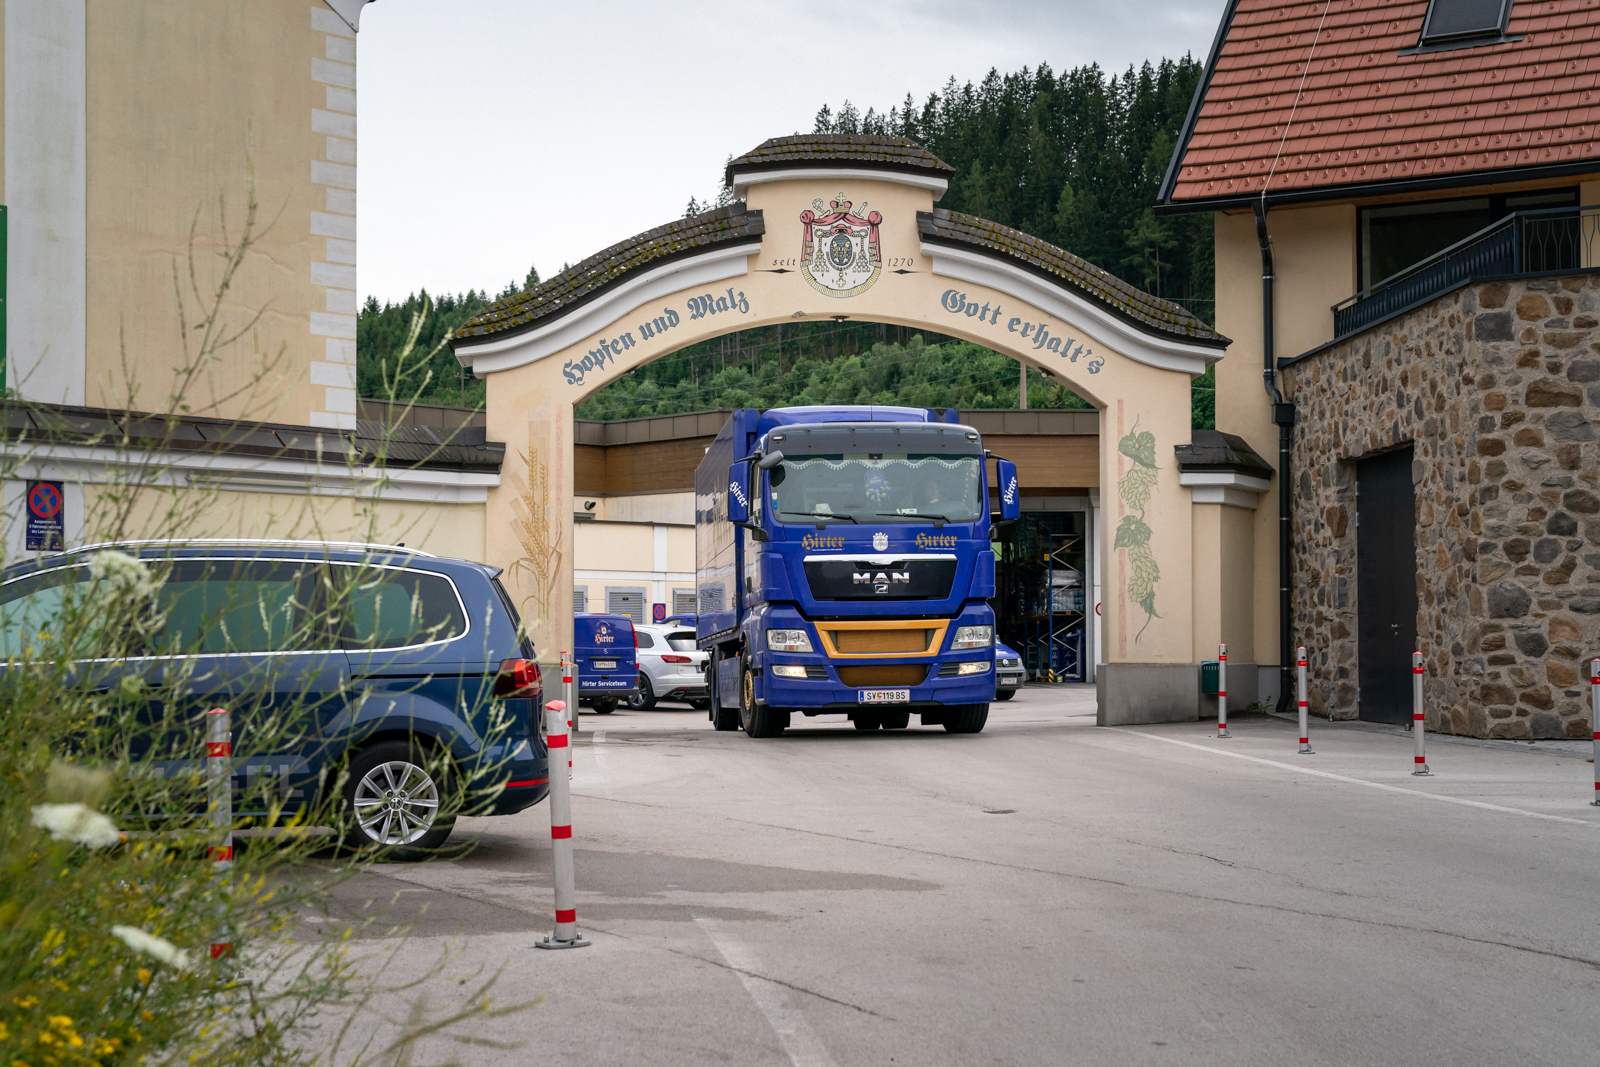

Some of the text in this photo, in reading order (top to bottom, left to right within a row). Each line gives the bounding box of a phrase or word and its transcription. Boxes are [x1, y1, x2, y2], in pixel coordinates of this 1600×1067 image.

[772, 257, 914, 267] seit 1270
[562, 287, 750, 386] Hopfen und Malz
[941, 289, 1105, 375] Gott erhalt's
[729, 481, 748, 507] Hirter
[1003, 476, 1017, 505] Hirter
[801, 533, 845, 552] Hirter
[915, 532, 958, 551] Hirter
[853, 572, 910, 584] MAN
[866, 692, 876, 700] SV
